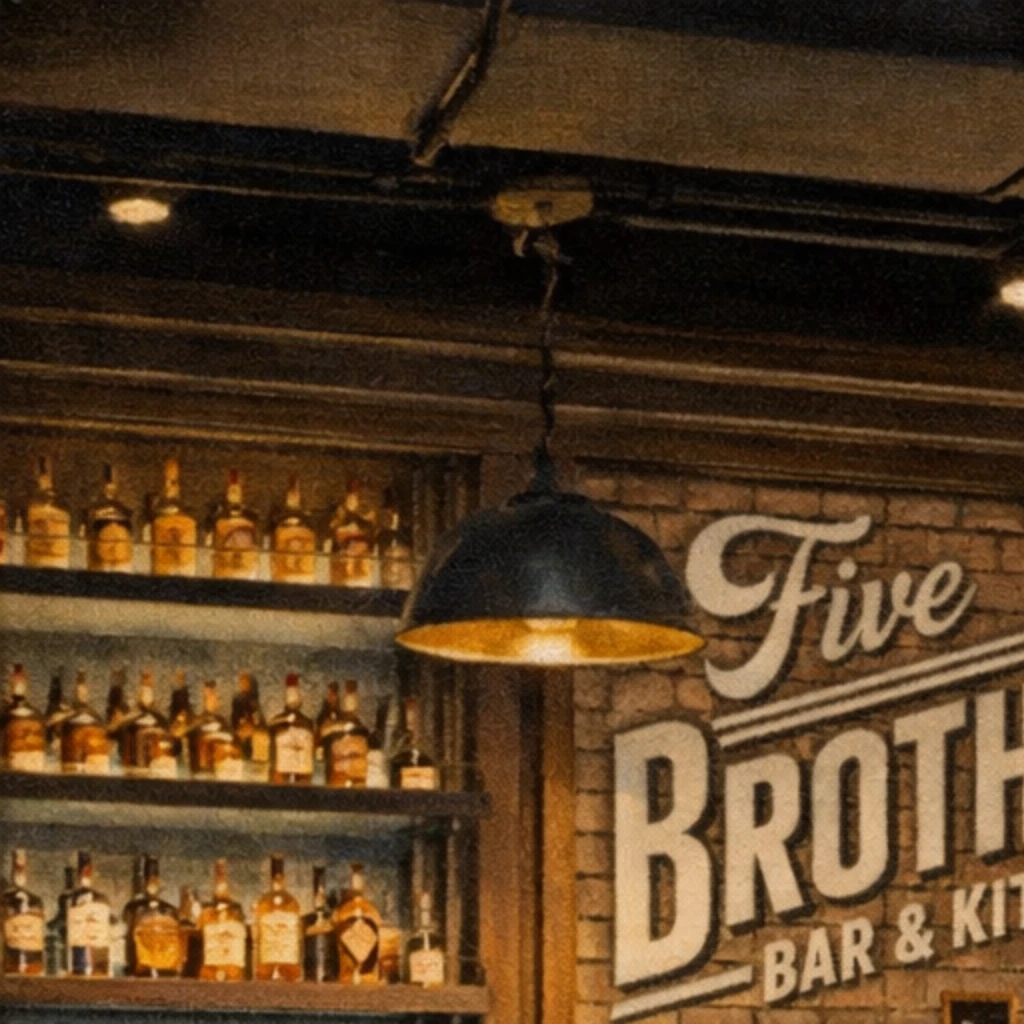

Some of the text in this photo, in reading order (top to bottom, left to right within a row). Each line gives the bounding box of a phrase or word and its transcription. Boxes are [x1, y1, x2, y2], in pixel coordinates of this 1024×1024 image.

[686, 514, 977, 700] Five
[763, 917, 875, 1001] BAR
[895, 902, 934, 963] &
